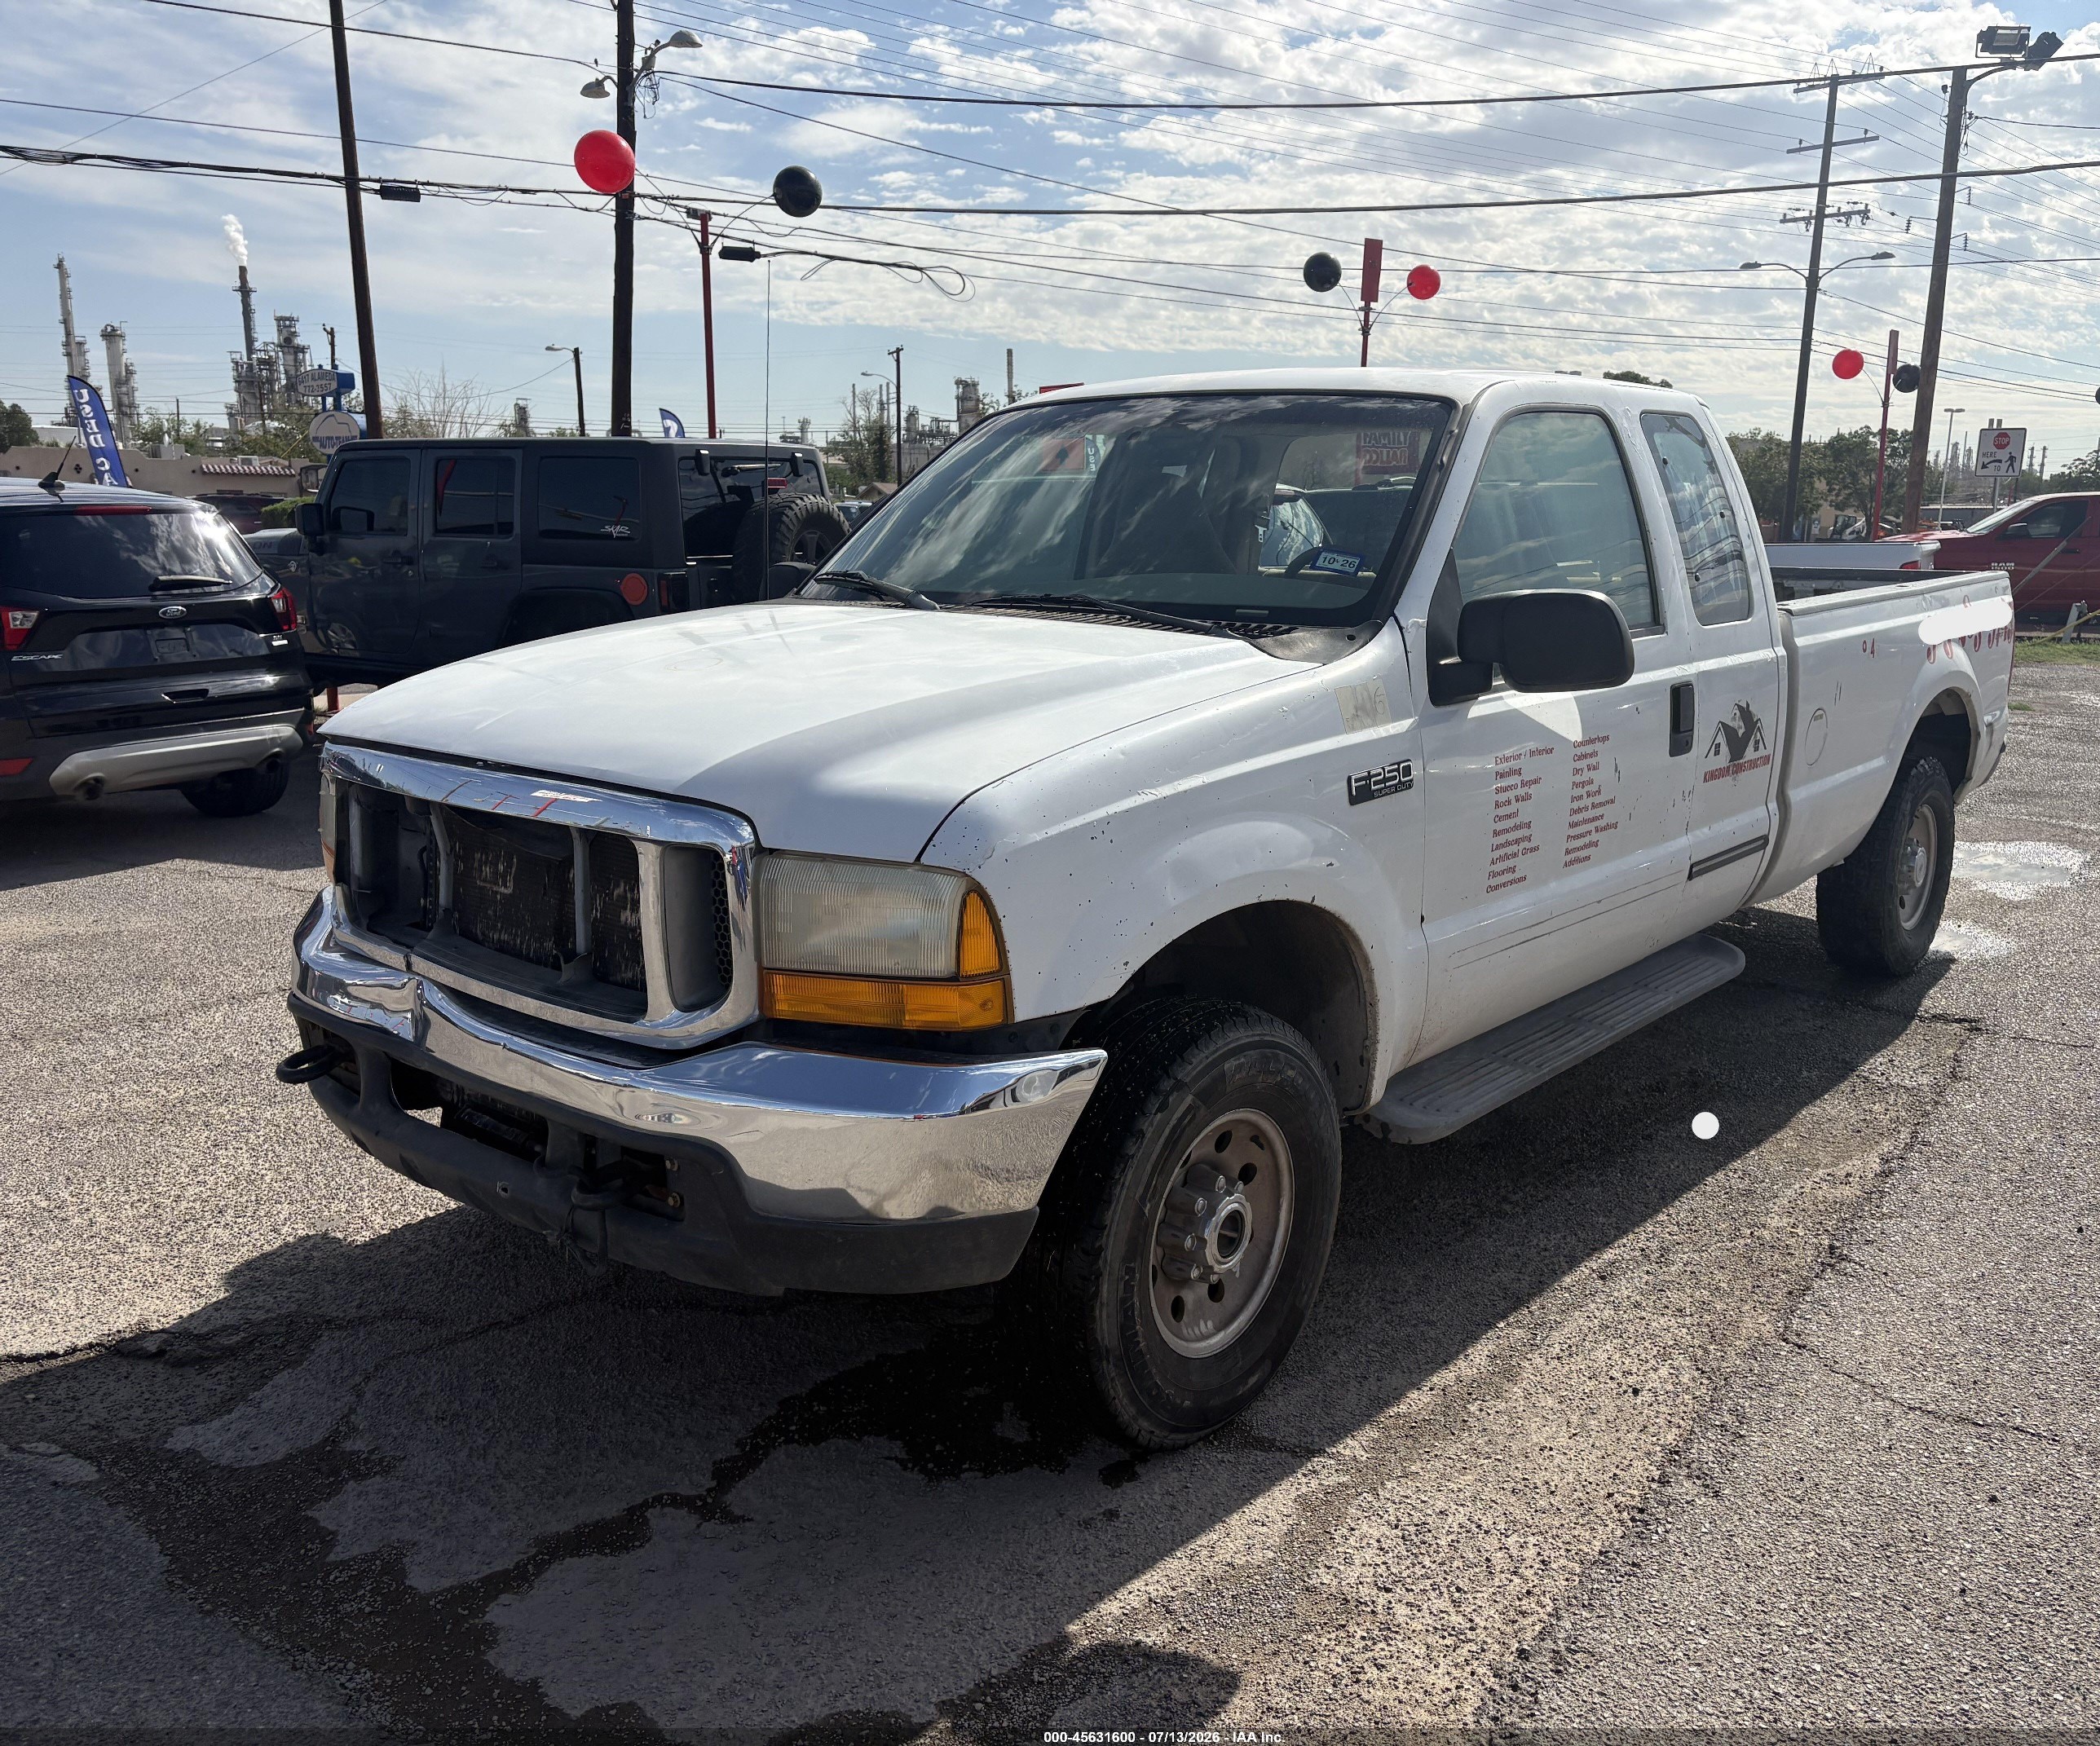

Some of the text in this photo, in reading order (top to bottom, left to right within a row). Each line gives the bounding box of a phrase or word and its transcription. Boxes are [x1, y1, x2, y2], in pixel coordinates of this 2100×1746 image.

[311, 372, 336, 381] ALAMEDA
[1361, 430, 1411, 447] FAMILY
[1322, 556, 1357, 568] 10 26
[1573, 734, 1610, 748] Countertops
[1495, 752, 1522, 766] Exterior
[1529, 747, 1555, 758] Interior
[1573, 749, 1599, 762] Cabinets
[1495, 767, 1522, 780] Painting
[1573, 761, 1599, 776] Dry Wall
[1703, 753, 1771, 783] KINGDOM CONSTRUCTION
[1351, 761, 1414, 796] F-250
[1495, 776, 1542, 795] Stucco Repair
[1572, 777, 1594, 790] Pergola
[1374, 781, 1414, 797] SUPER DUTY
[1571, 786, 1602, 803] Iron Work
[1494, 791, 1533, 809] Rock Walls
[1569, 796, 1616, 817] Debris Removal
[1493, 809, 1519, 823] Cement
[1568, 813, 1604, 830] Maintenance
[1493, 820, 1532, 838] Remodeling
[1566, 821, 1618, 843] Pressure Washing
[1491, 834, 1532, 853] Landscaping
[1564, 840, 1599, 857] Remodeling
[1489, 844, 1540, 866] Artificial Grass
[1563, 854, 1591, 869] Additions
[1488, 865, 1516, 880] Flooring
[1486, 875, 1527, 893] Conversions
